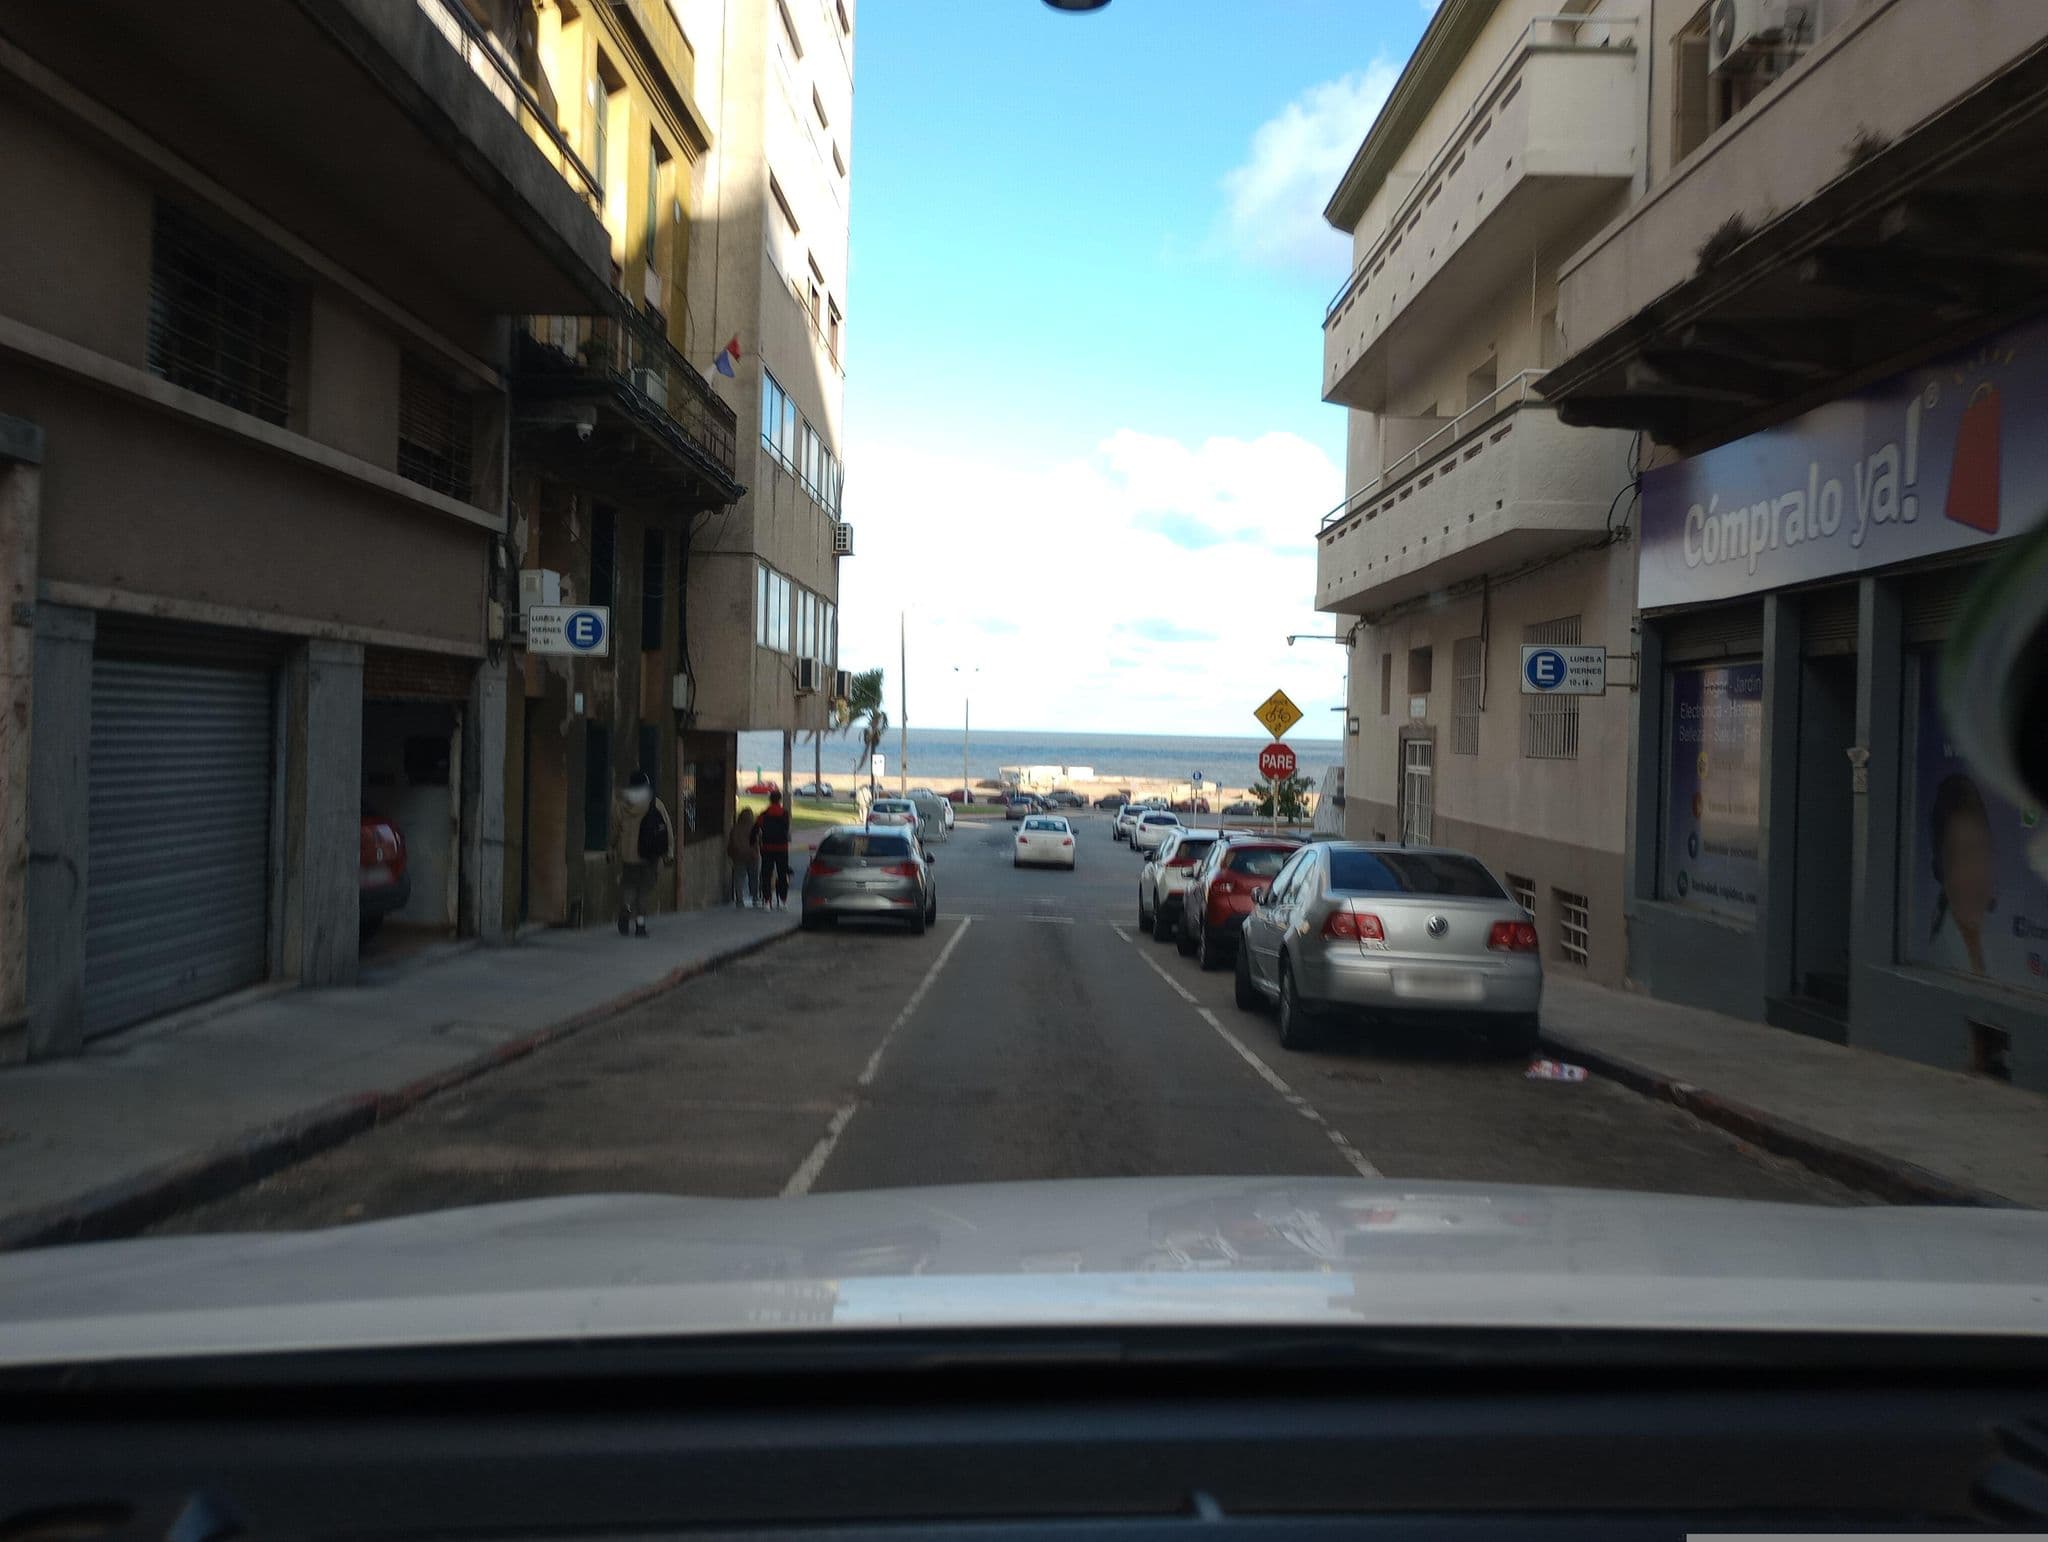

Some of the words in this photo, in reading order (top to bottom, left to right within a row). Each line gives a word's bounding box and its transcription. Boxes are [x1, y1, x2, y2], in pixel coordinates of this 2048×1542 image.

[1683, 463, 1843, 575] Cómpralo
[1851, 399, 1923, 548] ya!
[576, 616, 594, 641] E
[1536, 655, 1555, 680] E
[1262, 754, 1293, 769] PARE
